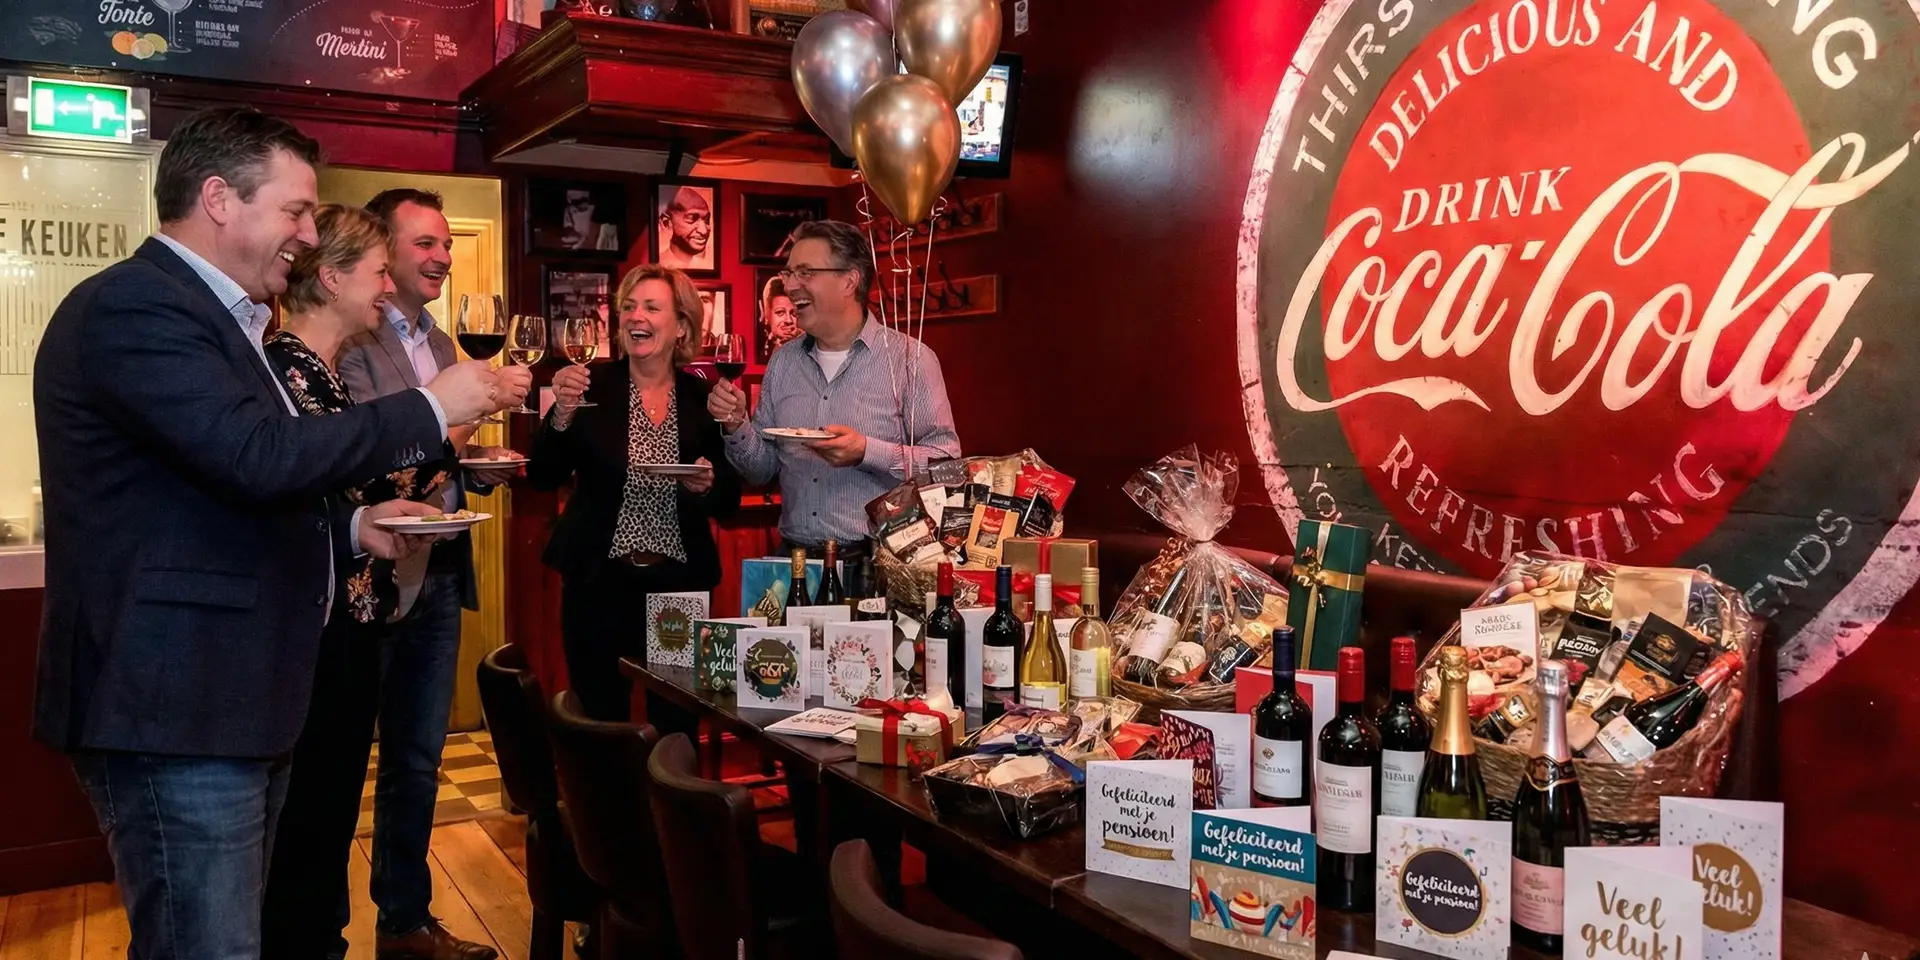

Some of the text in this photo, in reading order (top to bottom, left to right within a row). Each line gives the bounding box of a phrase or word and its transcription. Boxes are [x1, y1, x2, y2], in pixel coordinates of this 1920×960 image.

[1292, 0, 1415, 174] THIRS
[1369, 0, 1738, 173] DELICIOUS AND
[1392, 166, 1572, 233] DRINK
[21, 218, 128, 259] KEUKEN
[1277, 130, 1920, 416] Coca-Cola
[1378, 435, 1725, 564] REFRESHING
[1308, 467, 1343, 523] YO
[1744, 507, 1853, 619] ENDS
[1101, 783, 1176, 808] Gefeliciteerd
[1102, 820, 1175, 843] pensioen!
[1143, 807, 1158, 825] je
[1203, 820, 1304, 856] Gefeliciteerd
[1200, 844, 1305, 874] met je pensioen!
[1695, 853, 1743, 889] Veel
[1597, 880, 1666, 930] Veel
[1702, 882, 1755, 917] eluk!
[1580, 923, 1683, 960] geluk!
